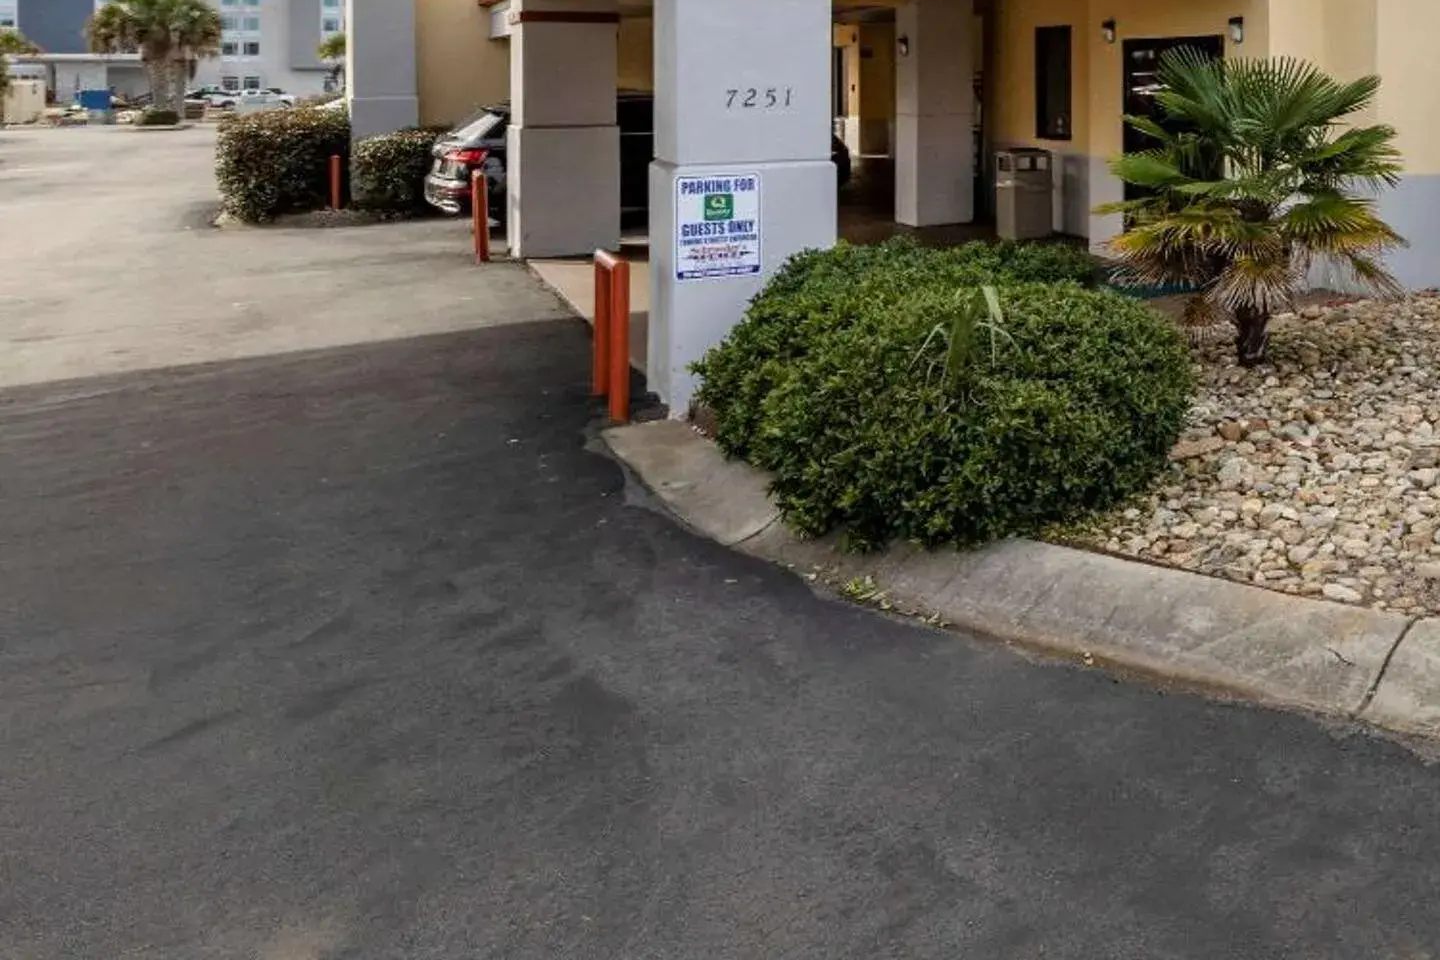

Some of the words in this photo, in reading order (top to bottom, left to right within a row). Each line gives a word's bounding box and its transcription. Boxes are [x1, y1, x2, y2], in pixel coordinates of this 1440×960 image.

[726, 87, 791, 108] 7251
[681, 179, 732, 194] PARKING
[734, 178, 755, 191] FOR
[681, 222, 726, 237] GUESTS
[728, 220, 755, 234] ONLY
